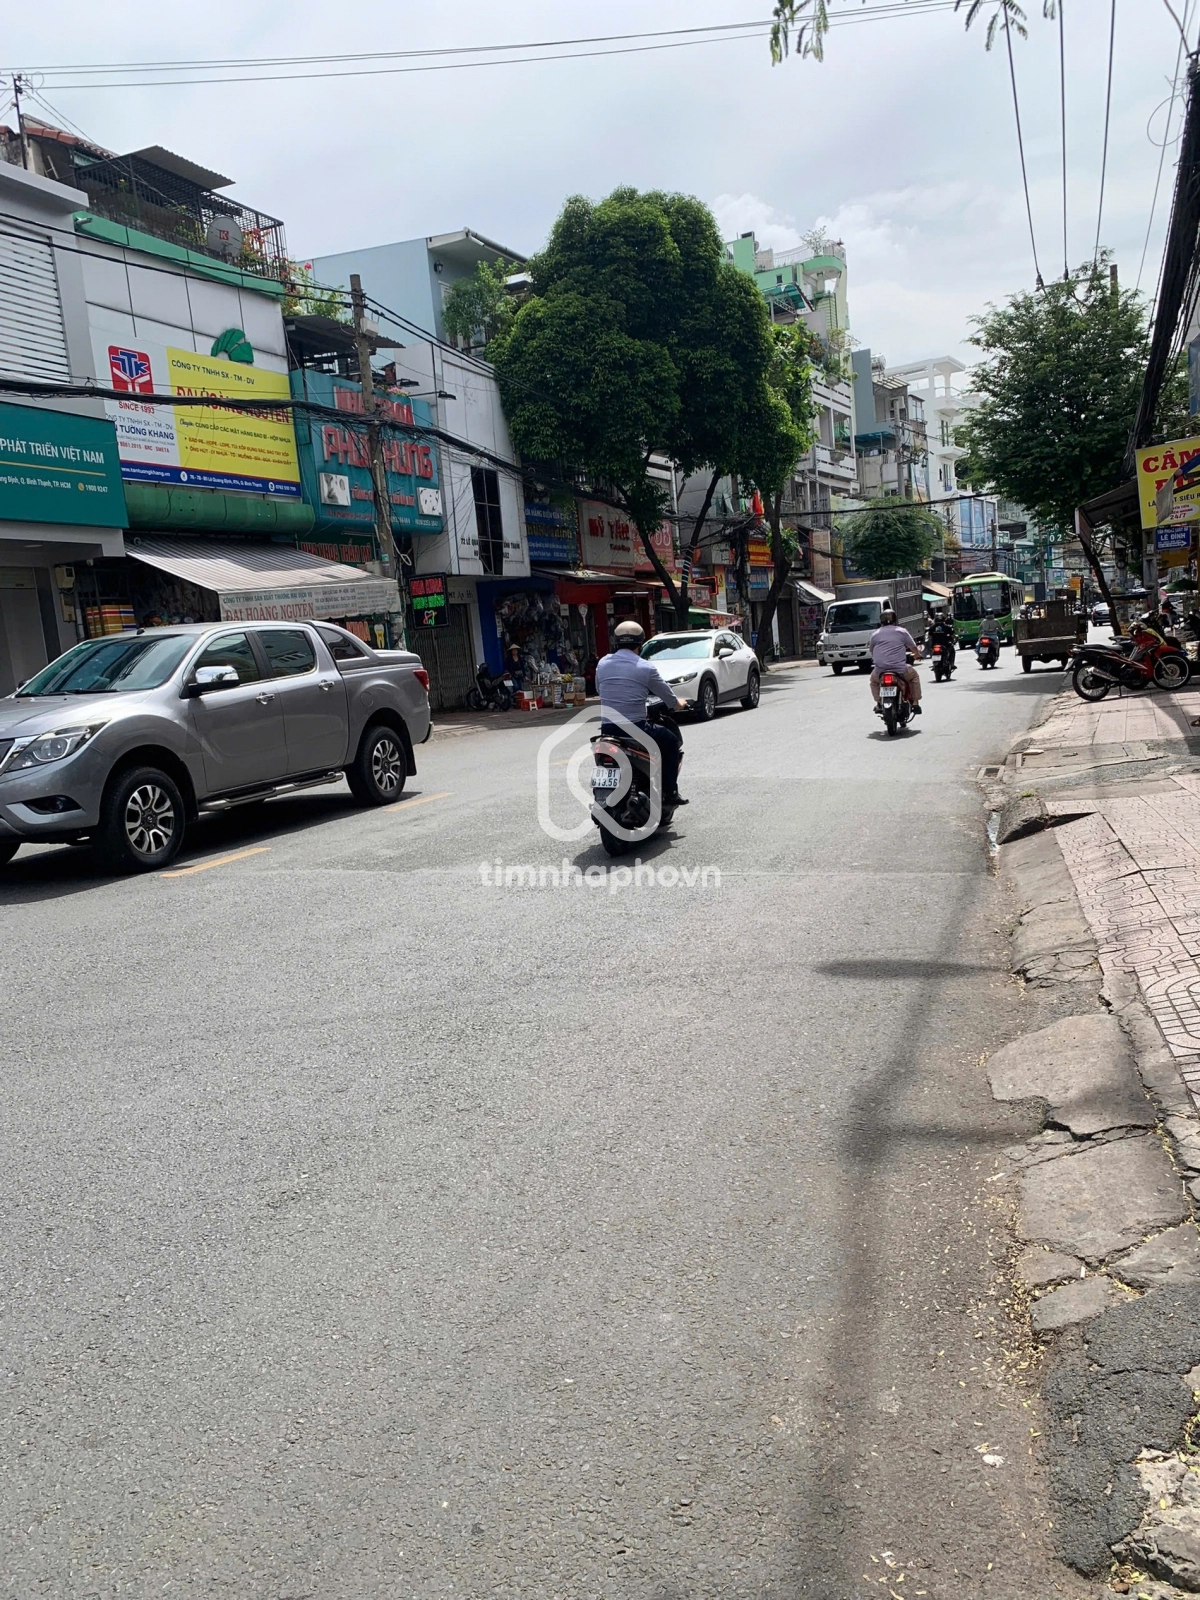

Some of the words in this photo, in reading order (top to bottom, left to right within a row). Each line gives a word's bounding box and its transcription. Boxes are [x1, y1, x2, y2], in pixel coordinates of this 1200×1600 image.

[172, 359, 191, 371] CÔNG
[192, 364, 201, 372] TY
[202, 366, 221, 377] TNHH
[221, 371, 229, 379] SX
[233, 374, 243, 382] TM
[247, 377, 255, 385] DV
[119, 401, 139, 412] SINCE
[140, 402, 155, 415] 1993
[127, 417, 142, 425] TNHH
[120, 424, 147, 436] TƯỜNG
[148, 428, 175, 441] KHANG
[0, 438, 26, 454] PHÁT
[60, 446, 81, 462] VIỆT
[83, 450, 105, 464] NAM
[245, 602, 278, 621] HOÀNG
[280, 599, 314, 619] NGUYÊN
